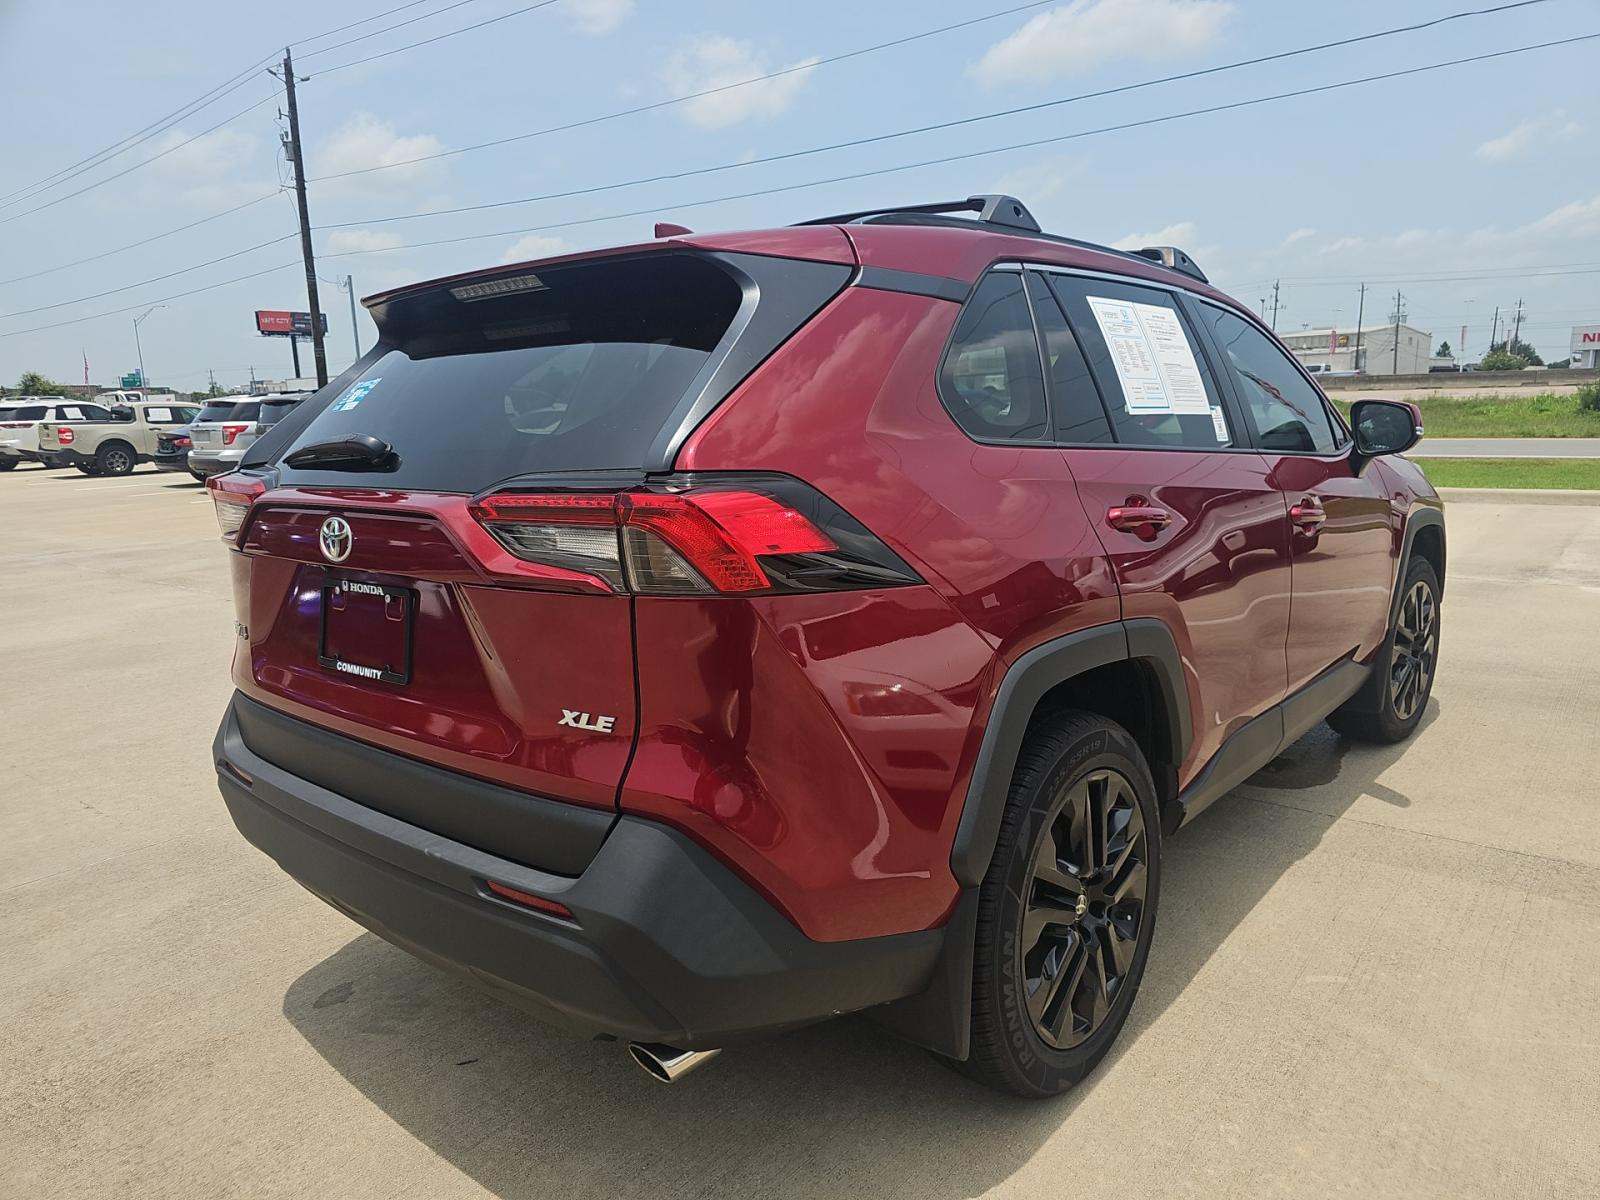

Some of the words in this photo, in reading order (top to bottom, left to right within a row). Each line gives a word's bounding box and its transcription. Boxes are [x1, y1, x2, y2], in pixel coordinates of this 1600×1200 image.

[350, 582, 385, 596] HONDA
[336, 661, 383, 680] COMMUNITY
[557, 709, 616, 734] XLE
[1002, 930, 1037, 1070] IRONMAN
